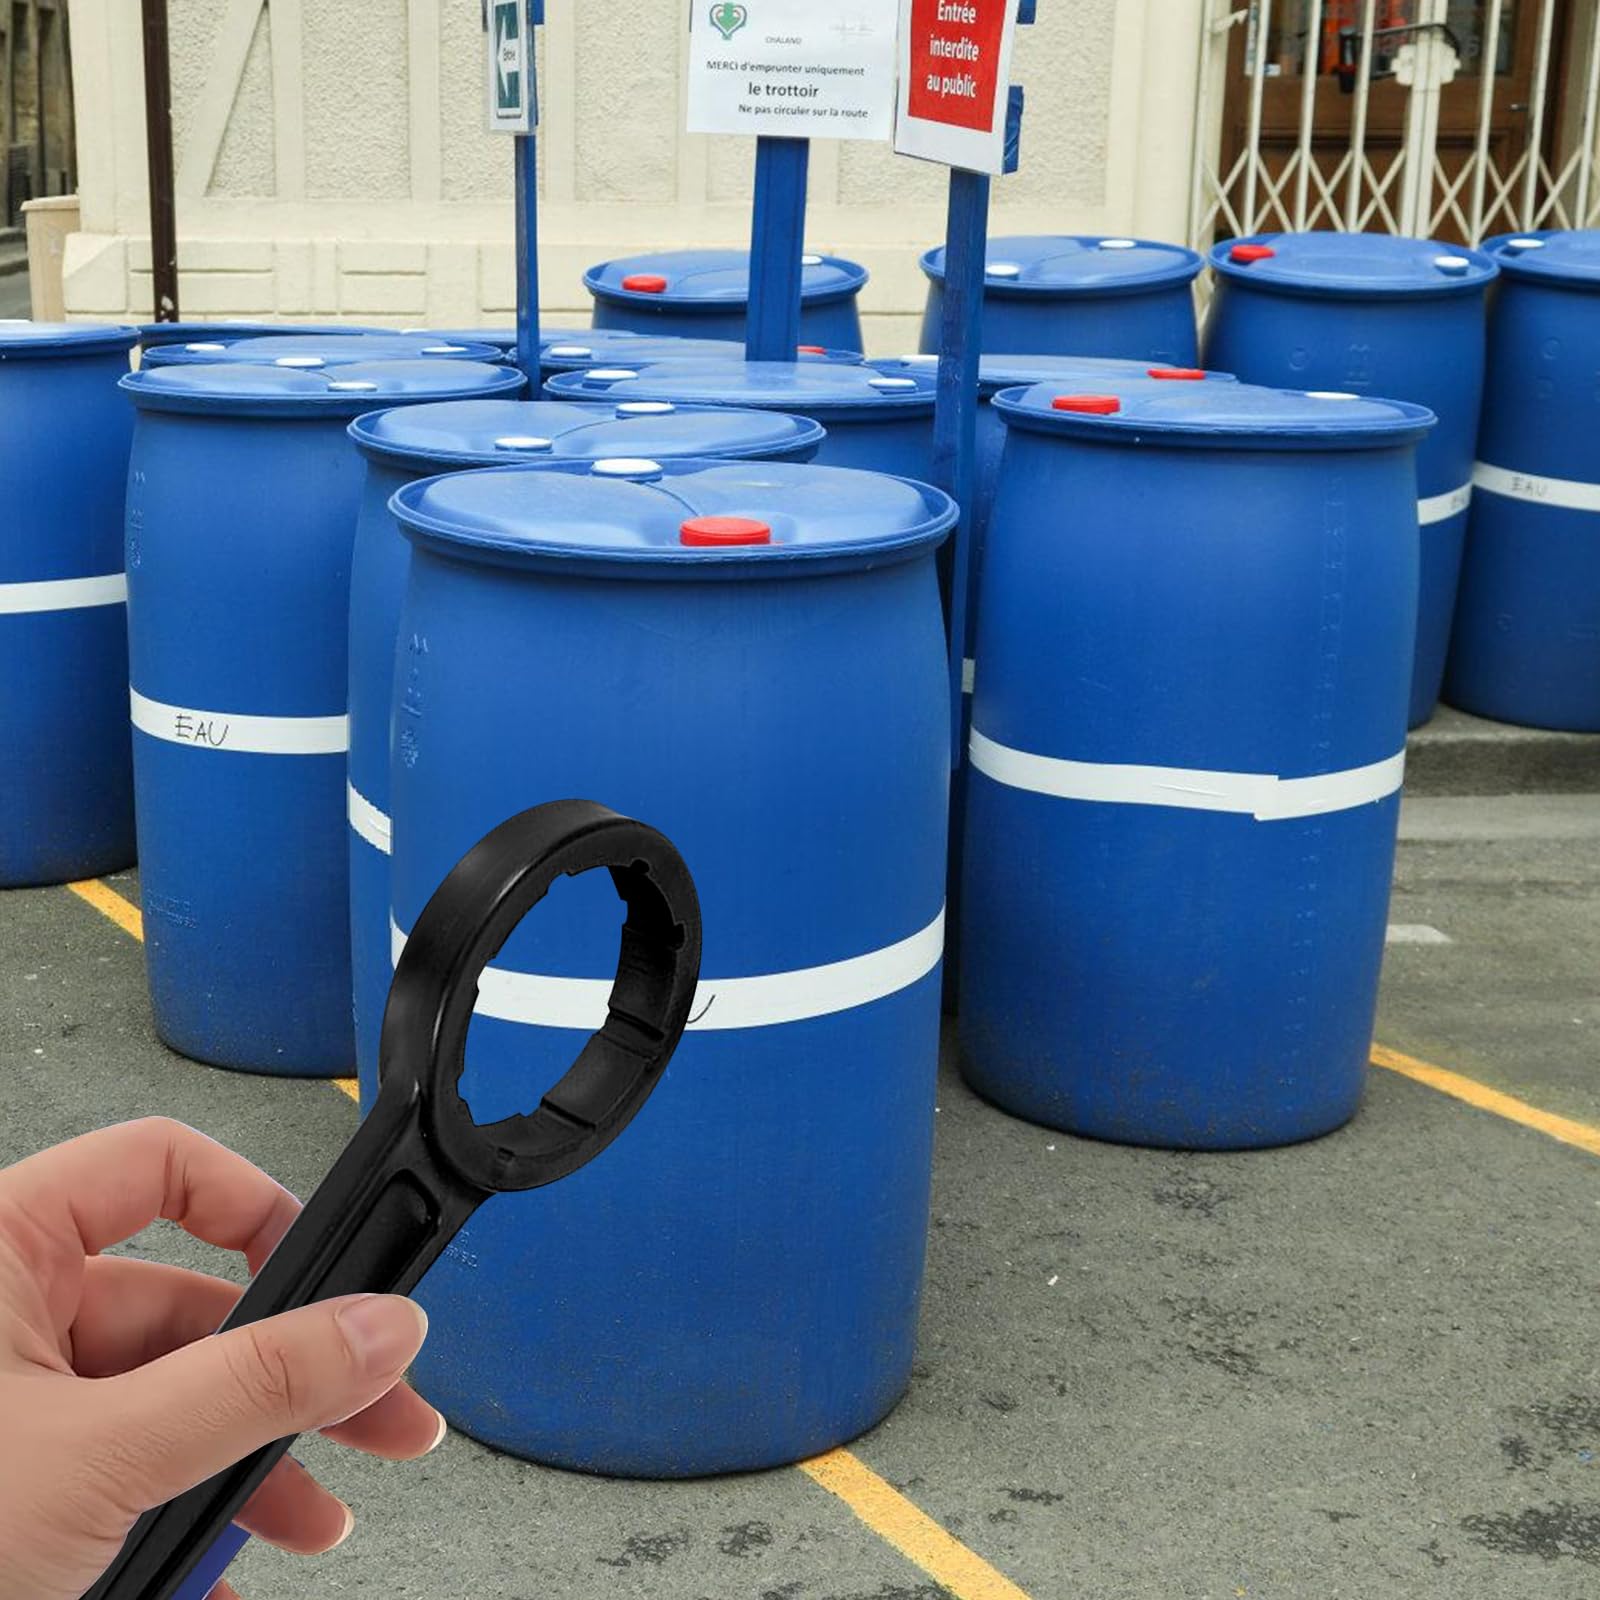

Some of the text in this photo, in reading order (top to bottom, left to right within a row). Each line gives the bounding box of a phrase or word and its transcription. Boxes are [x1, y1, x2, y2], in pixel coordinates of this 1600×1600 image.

[937, 0, 977, 24] Entrée
[929, 33, 980, 62] interdite
[706, 60, 865, 77] MERCI d'emprunter uniquement
[748, 81, 820, 98] le trottoir
[926, 72, 977, 98] au public
[738, 103, 869, 119] Ne pas circuler sur la route
[174, 713, 230, 747] EAU
